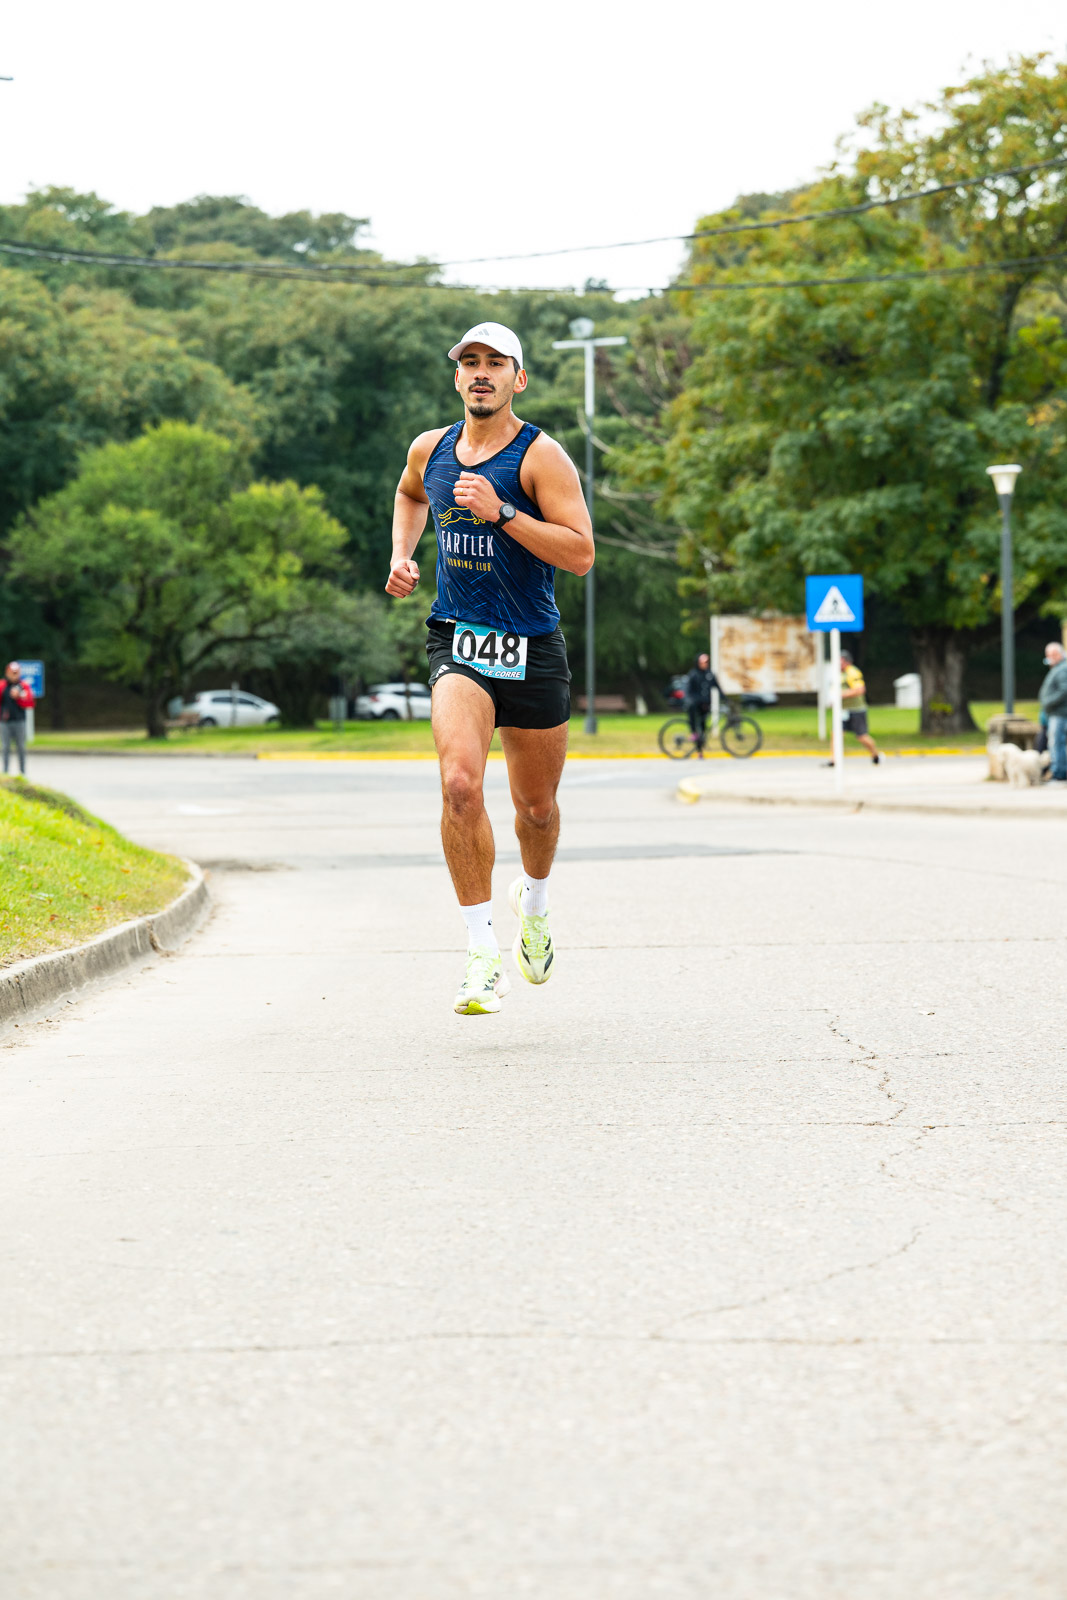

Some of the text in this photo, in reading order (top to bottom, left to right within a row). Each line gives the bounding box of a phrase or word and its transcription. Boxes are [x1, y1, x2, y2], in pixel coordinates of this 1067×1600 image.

[442, 530, 494, 556] FARTLEK
[476, 561, 491, 571] CLUB
[457, 629, 520, 669] 048
